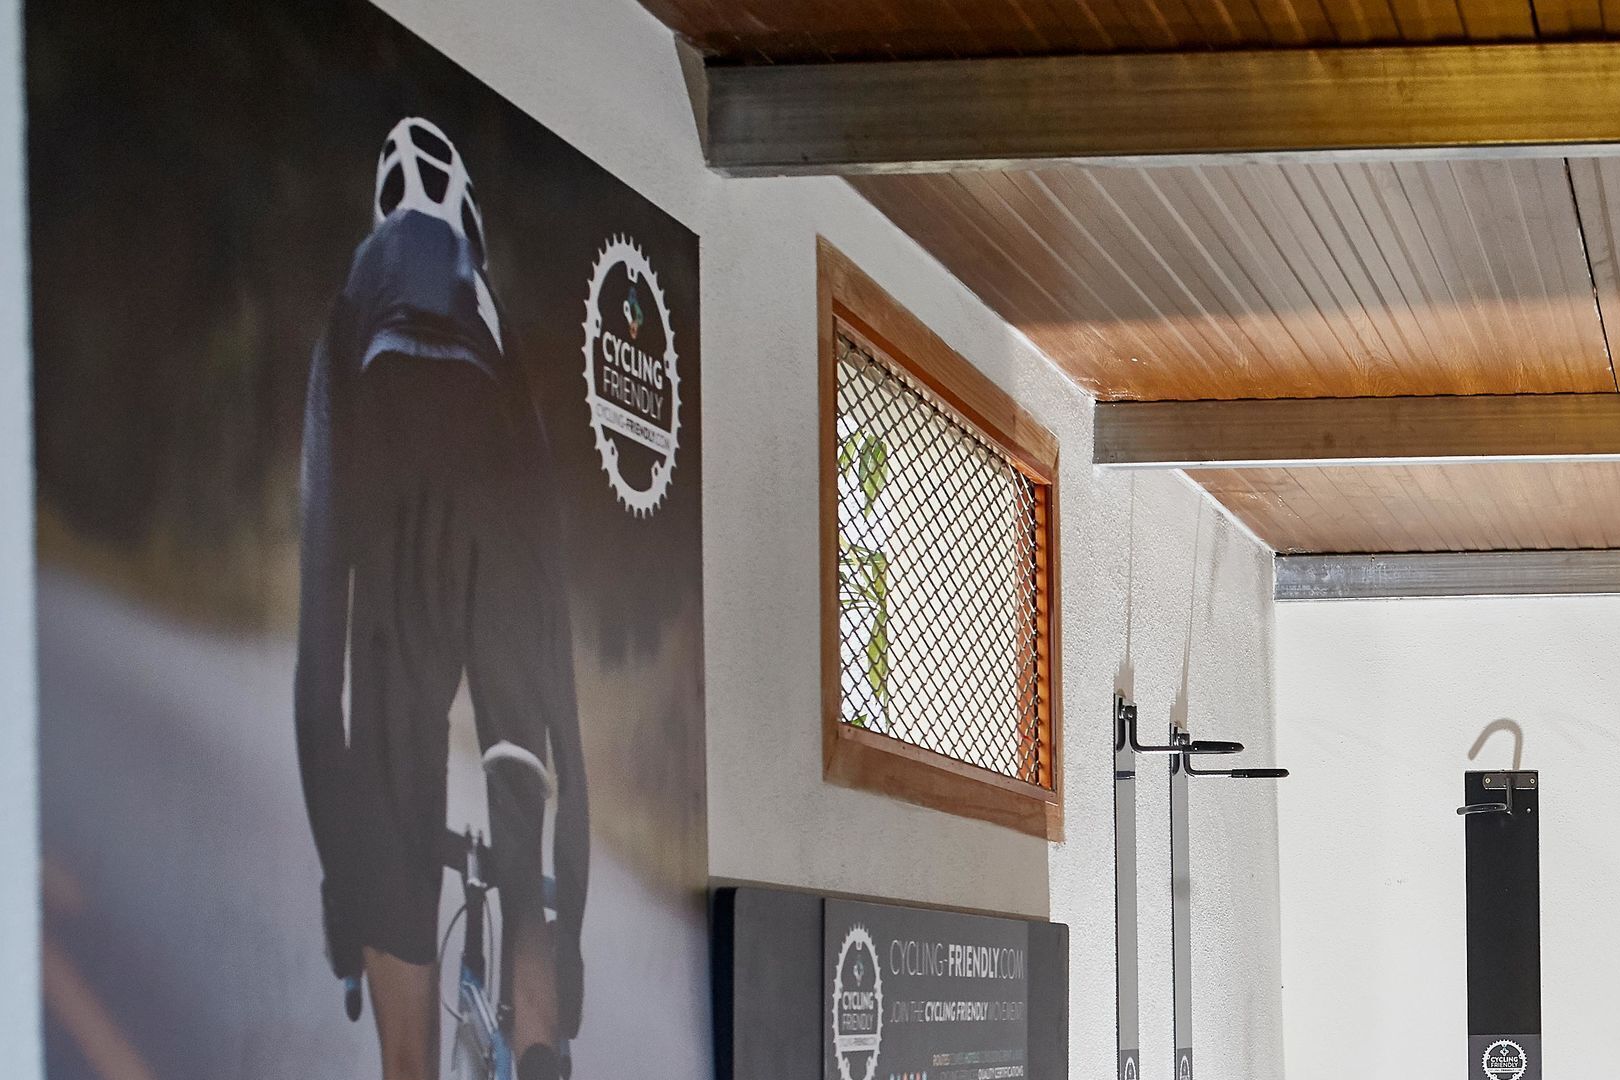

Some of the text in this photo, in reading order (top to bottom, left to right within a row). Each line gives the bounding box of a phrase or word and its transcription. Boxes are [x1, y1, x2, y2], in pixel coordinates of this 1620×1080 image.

[602, 331, 663, 390] CYCLING
[603, 366, 664, 420] FRIENDLY
[890, 940, 1024, 979] CYCLING-FRIENDLY.COM
[842, 991, 874, 1010] CYCLING
[924, 1001, 956, 1022] CYCLING
[956, 1001, 988, 1022] FRIENDLY
[842, 1013, 874, 1031] FRIENDLY
